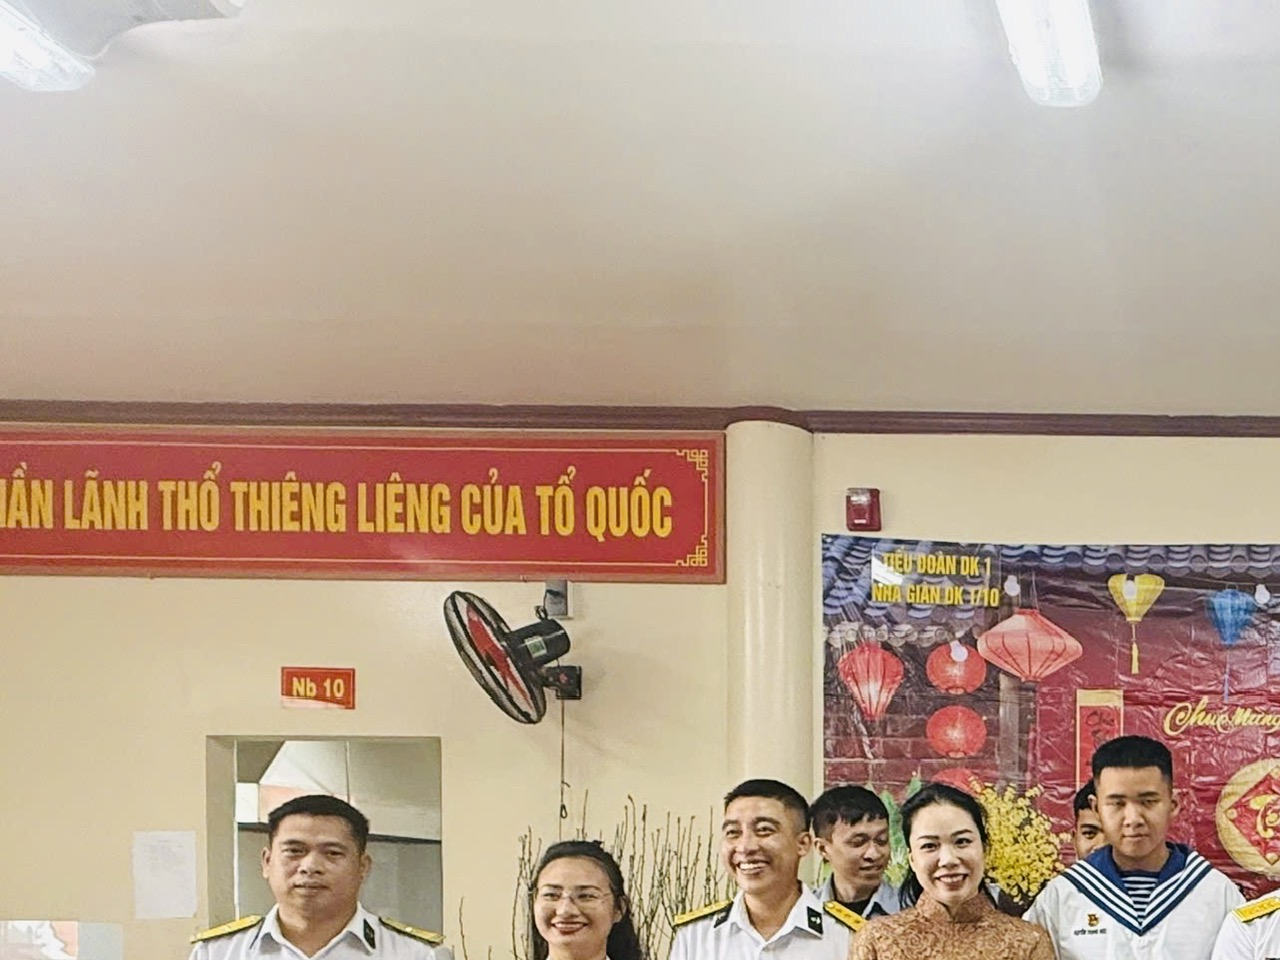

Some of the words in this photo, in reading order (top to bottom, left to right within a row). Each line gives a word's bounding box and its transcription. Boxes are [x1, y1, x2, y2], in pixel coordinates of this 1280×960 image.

[64, 470, 148, 531] LÃNH
[158, 461, 222, 532] THỔ
[230, 471, 346, 532] THIÊNG
[357, 472, 450, 533] LIÊNG
[461, 467, 526, 535] CỦA
[535, 466, 576, 536] TỔ
[585, 468, 673, 542] QUỐC
[984, 557, 992, 577] 1
[292, 677, 317, 697] Nb
[323, 678, 345, 698] 10
